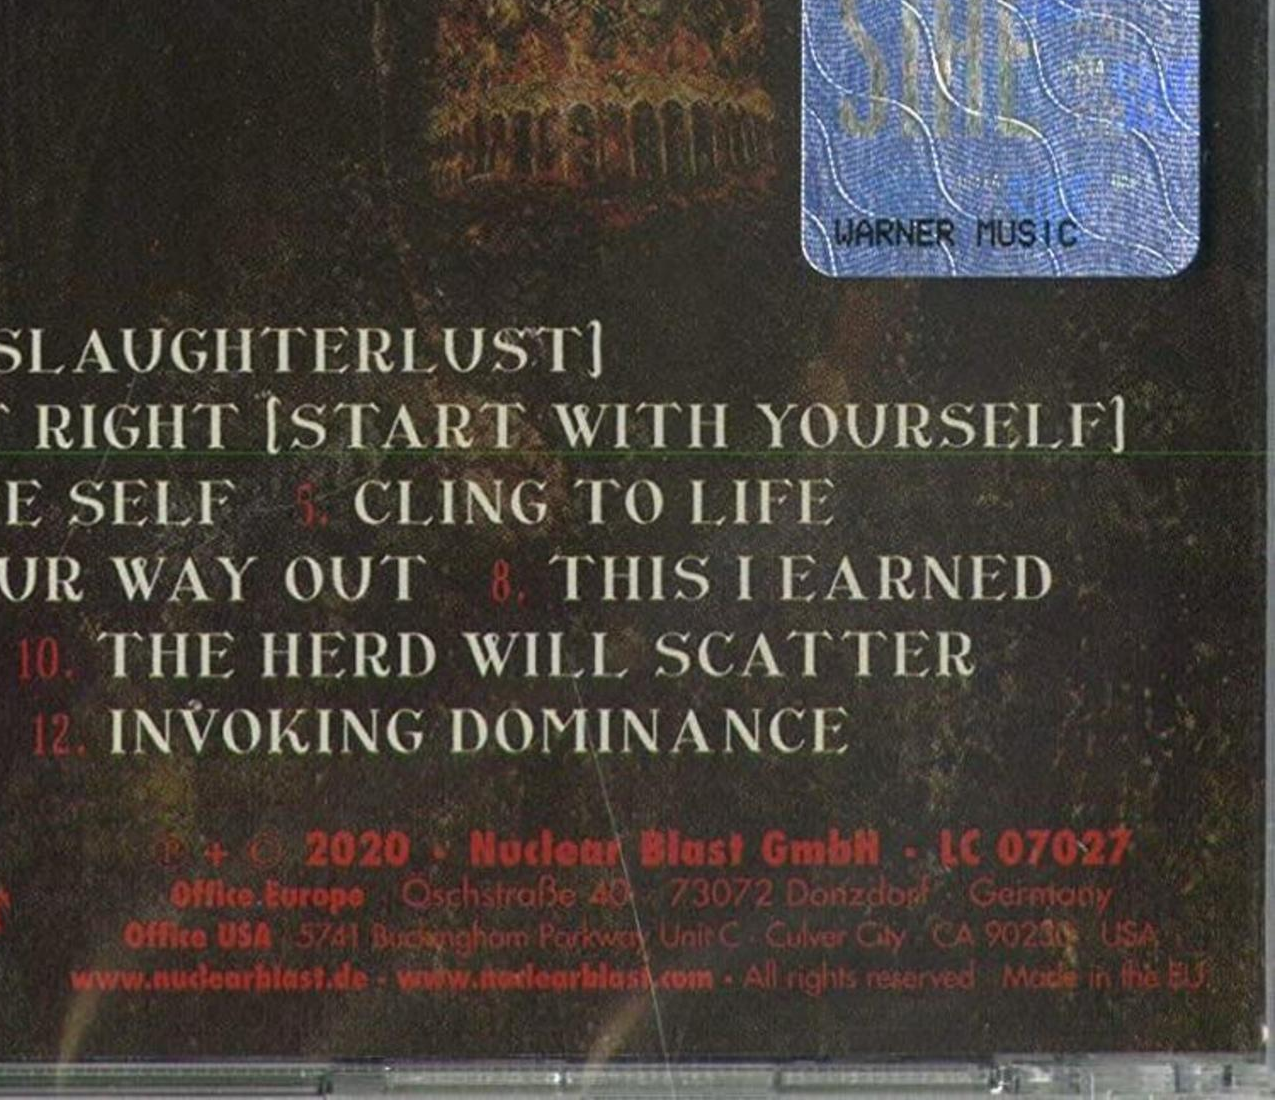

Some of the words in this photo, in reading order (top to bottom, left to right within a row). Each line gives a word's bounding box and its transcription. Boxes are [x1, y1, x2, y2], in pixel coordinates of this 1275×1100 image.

[834, 217, 955, 247] WARNER
[977, 218, 1078, 247] MUSIC
[35, 403, 239, 450] RIGHT
[266, 395, 526, 454] [START
[552, 402, 729, 450] WITH
[755, 394, 1125, 454] YOURSELF]
[67, 479, 236, 527] SELF
[353, 479, 548, 527] CLING
[573, 478, 664, 526] TO
[689, 477, 835, 527] LIFE
[110, 555, 259, 602] WAY
[284, 555, 426, 602] OUT
[547, 555, 711, 601] THIS
[736, 555, 756, 601] I
[779, 554, 1053, 601] EARNED
[96, 632, 235, 679] THE
[260, 631, 437, 679] HERD
[462, 631, 628, 678] WILL
[653, 630, 976, 678] SCATTER
[110, 708, 424, 755] INVOKING
[450, 706, 849, 754] DOMINANCE
[306, 829, 411, 868] 2020
[469, 828, 621, 867] Nuclear
[640, 828, 744, 868] Blast
[761, 828, 880, 867] GmbH
[937, 828, 982, 867] LC
[996, 828, 1133, 867] 07027
[171, 878, 254, 908] Office
[266, 877, 366, 913] Europe
[670, 878, 774, 908] 73072
[970, 874, 1114, 914] Germany
[124, 920, 207, 949] Office
[218, 920, 272, 949] USA
[856, 920, 908, 954] City
[932, 921, 974, 948] CA
[70, 960, 369, 991] www.nuclearblast.de
[744, 960, 776, 989] All
[866, 959, 975, 990] reserved
